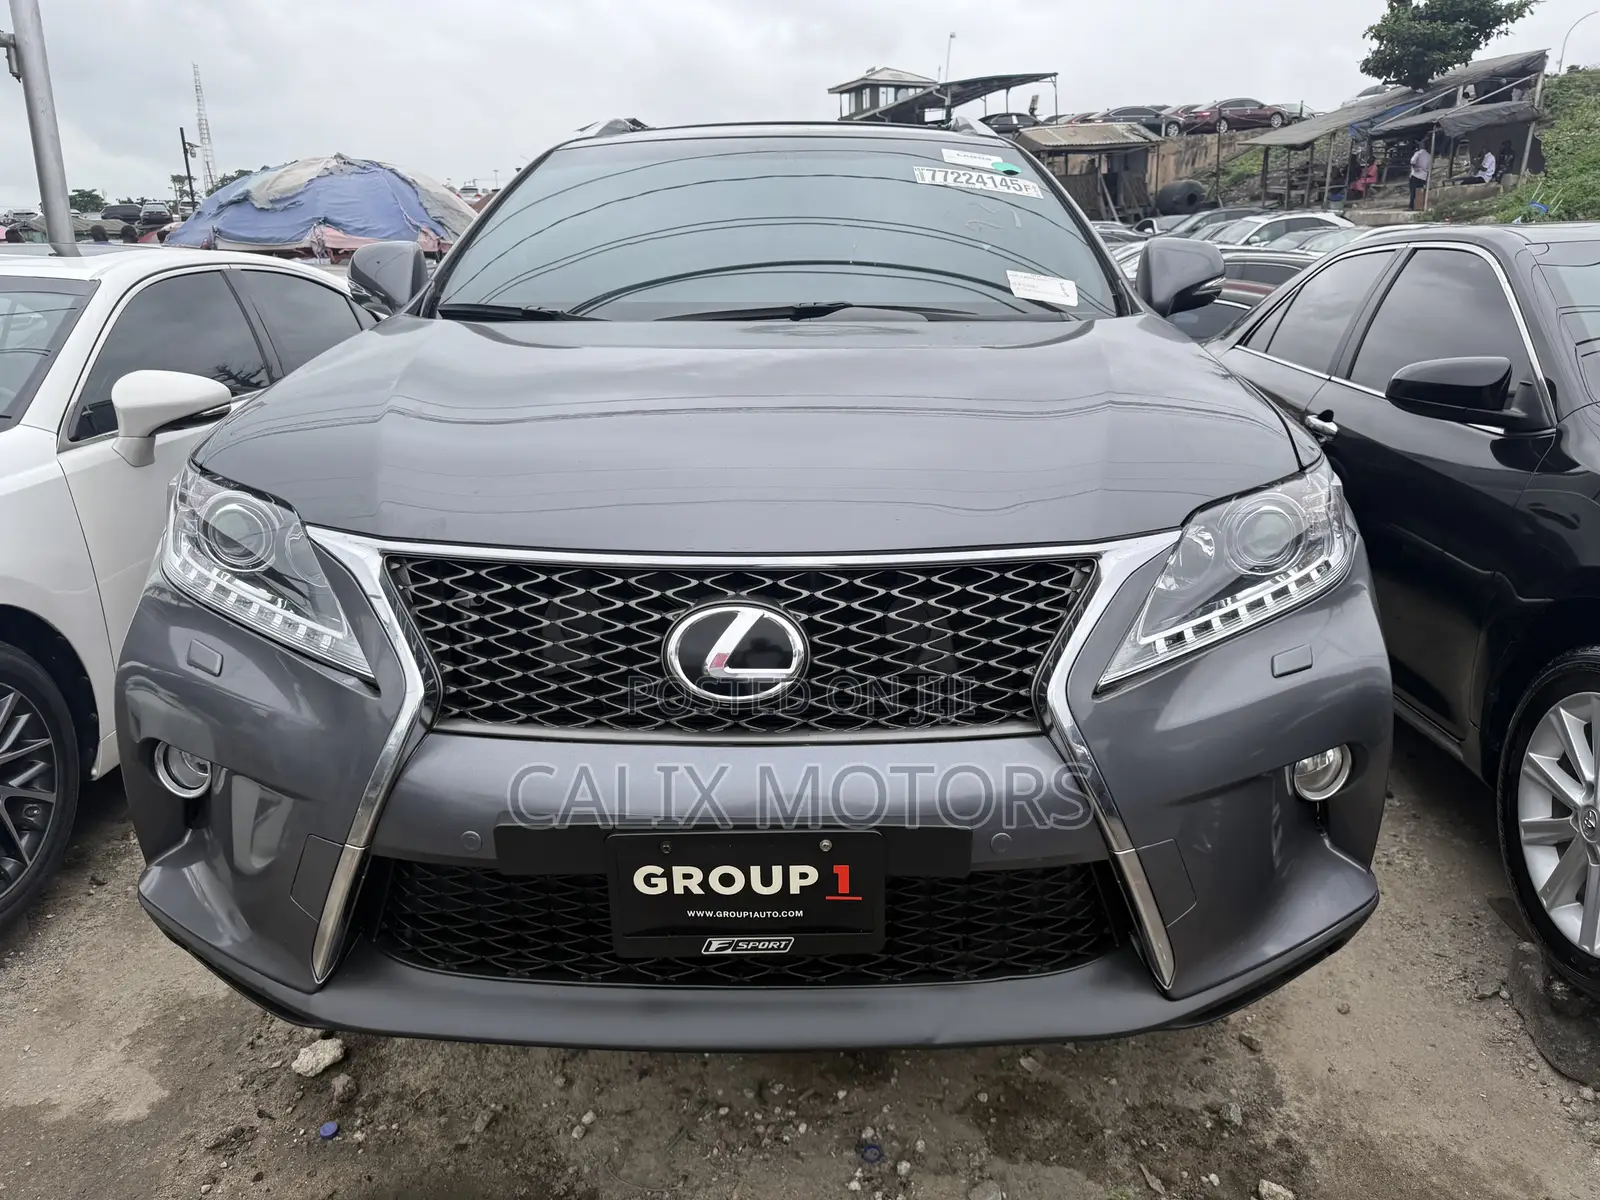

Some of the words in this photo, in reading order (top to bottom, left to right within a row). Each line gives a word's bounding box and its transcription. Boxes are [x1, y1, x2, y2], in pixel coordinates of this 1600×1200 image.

[633, 865, 819, 895] GROUP
[832, 864, 850, 894] 1
[686, 910, 804, 918] WWW.GROUP1AUTO.COM
[710, 940, 733, 952] F
[737, 940, 789, 950] SPORT
